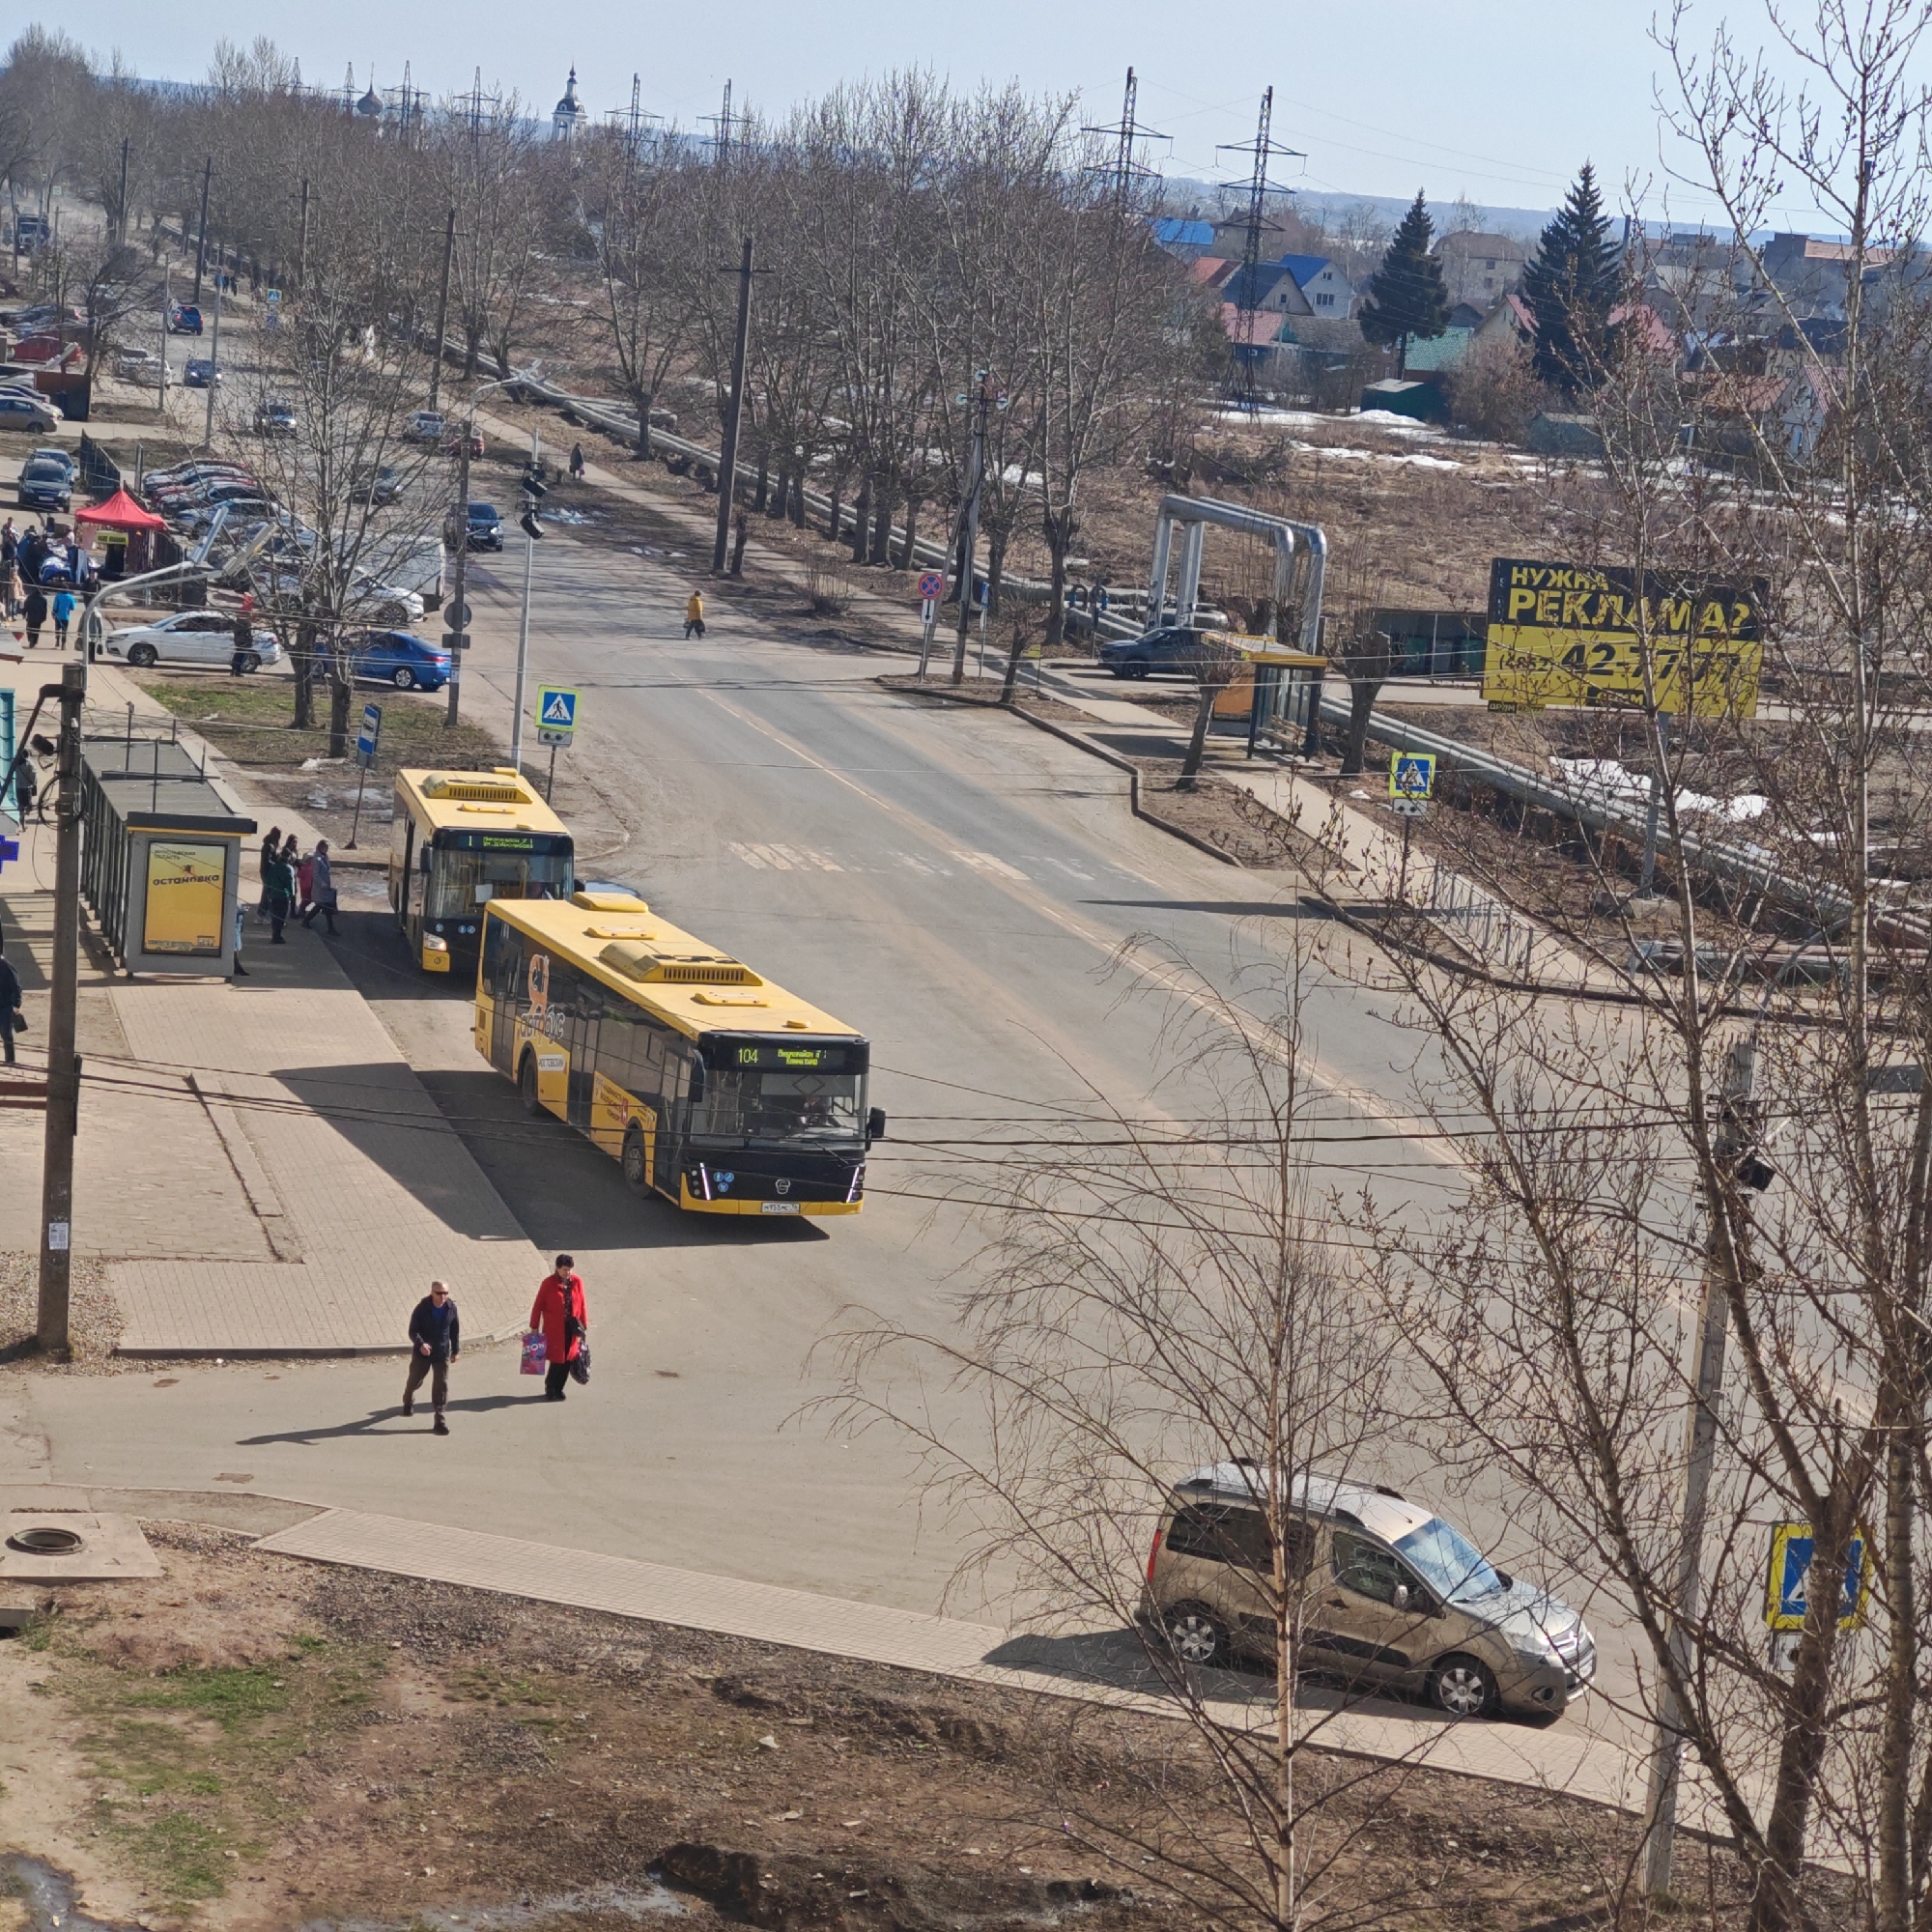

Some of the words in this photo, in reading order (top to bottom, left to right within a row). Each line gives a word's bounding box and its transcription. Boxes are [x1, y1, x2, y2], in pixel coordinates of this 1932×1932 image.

[1511, 566, 1609, 591] НУЖНА
[1508, 587, 1750, 635] РЕКЛАМА?
[738, 1048, 759, 1065] 104
